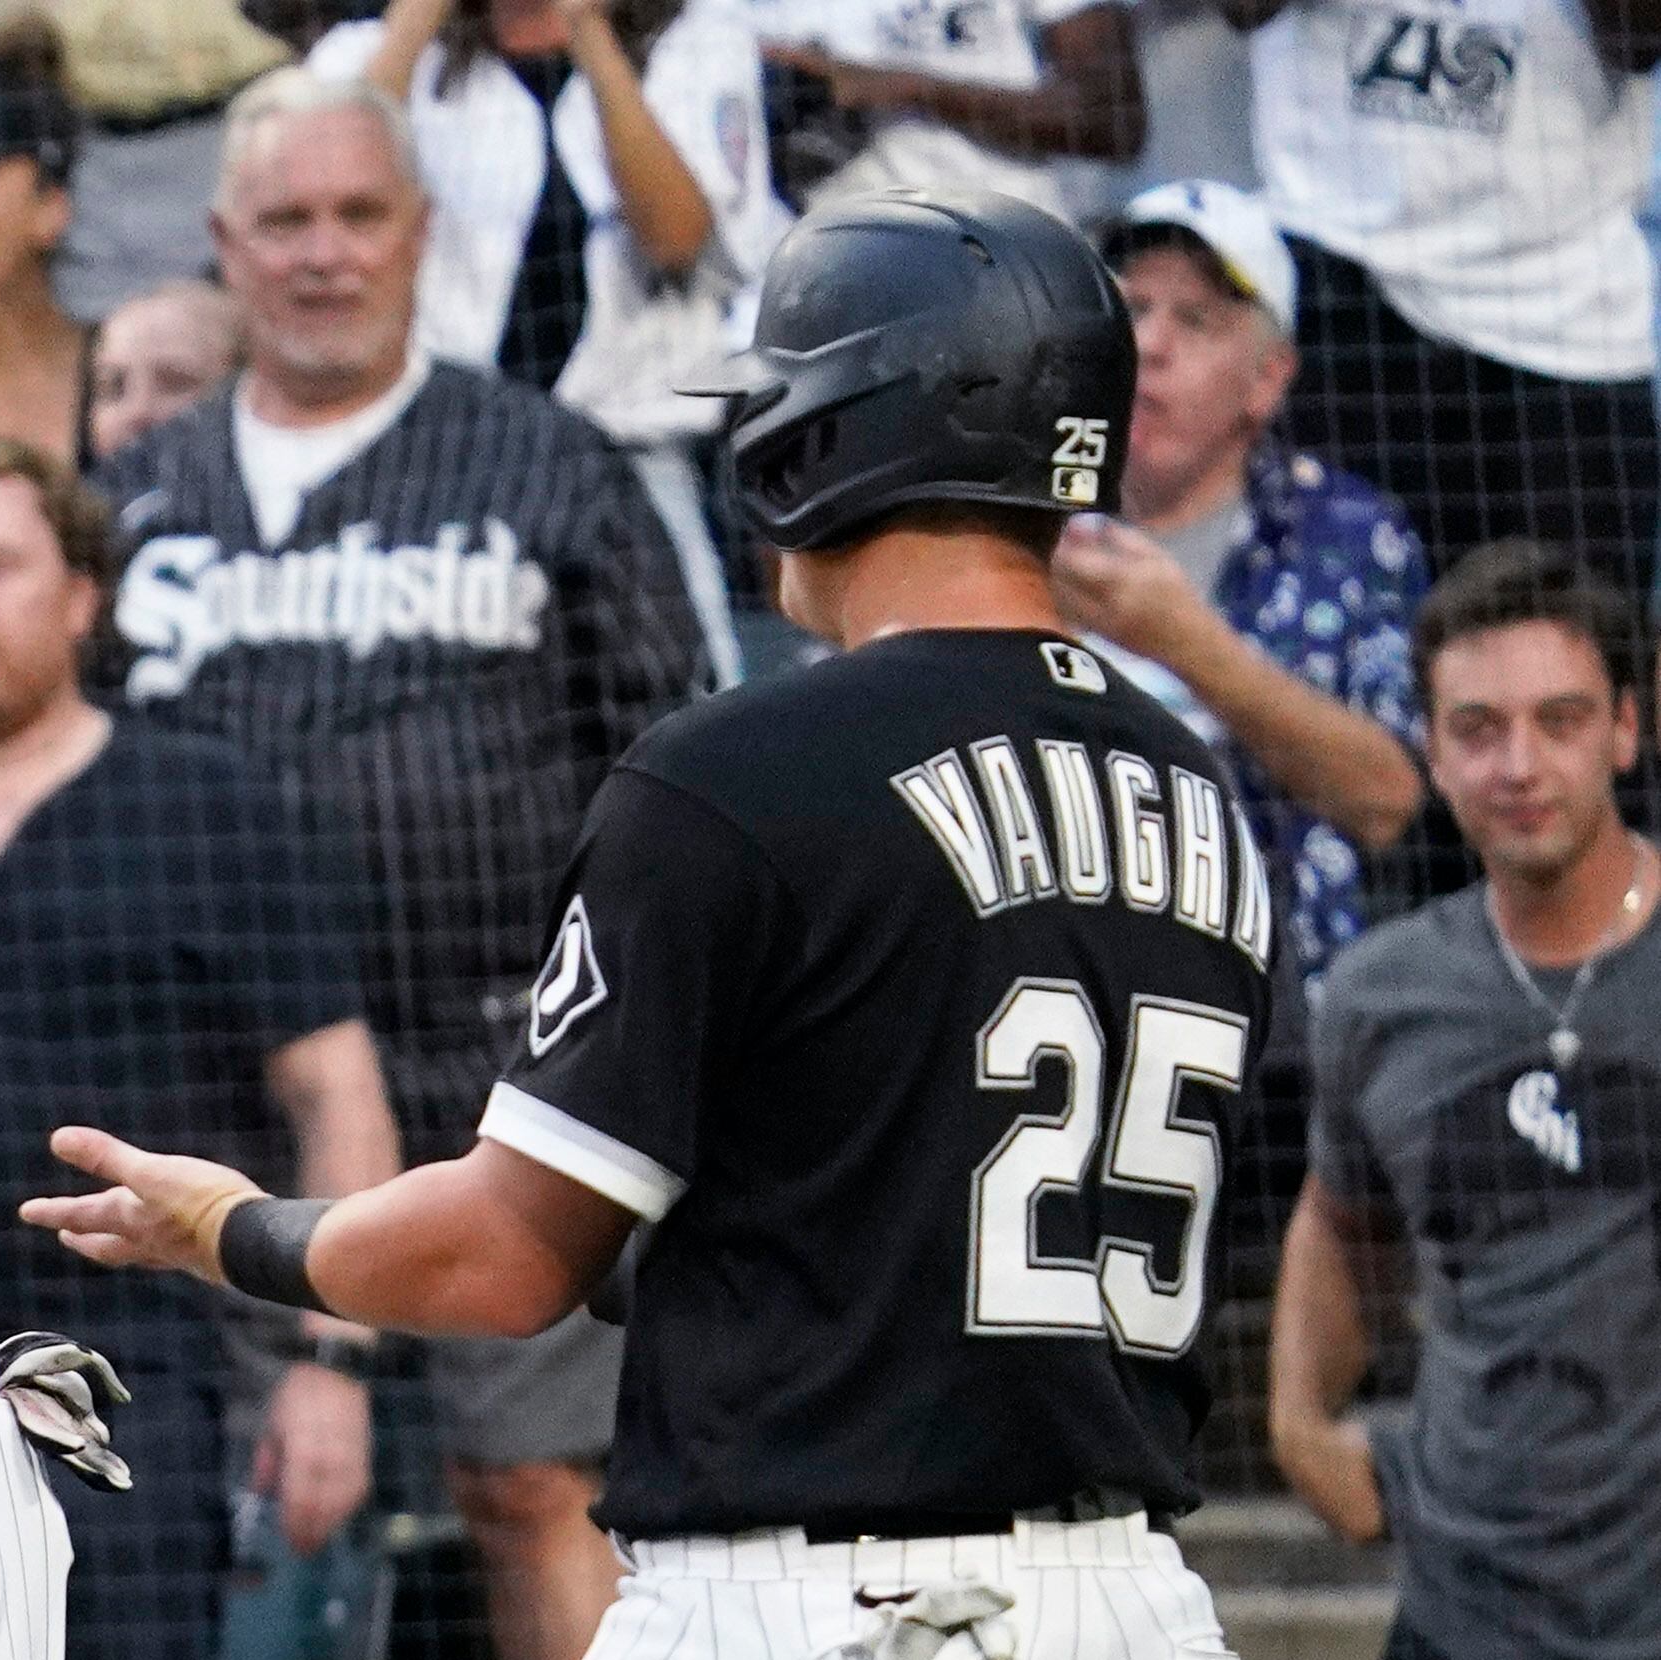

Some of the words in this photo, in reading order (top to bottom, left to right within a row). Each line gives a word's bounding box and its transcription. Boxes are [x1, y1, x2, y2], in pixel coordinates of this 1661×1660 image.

[1052, 416, 1109, 467] 25
[115, 517, 548, 704] Southside
[965, 976, 1250, 1360] 25
